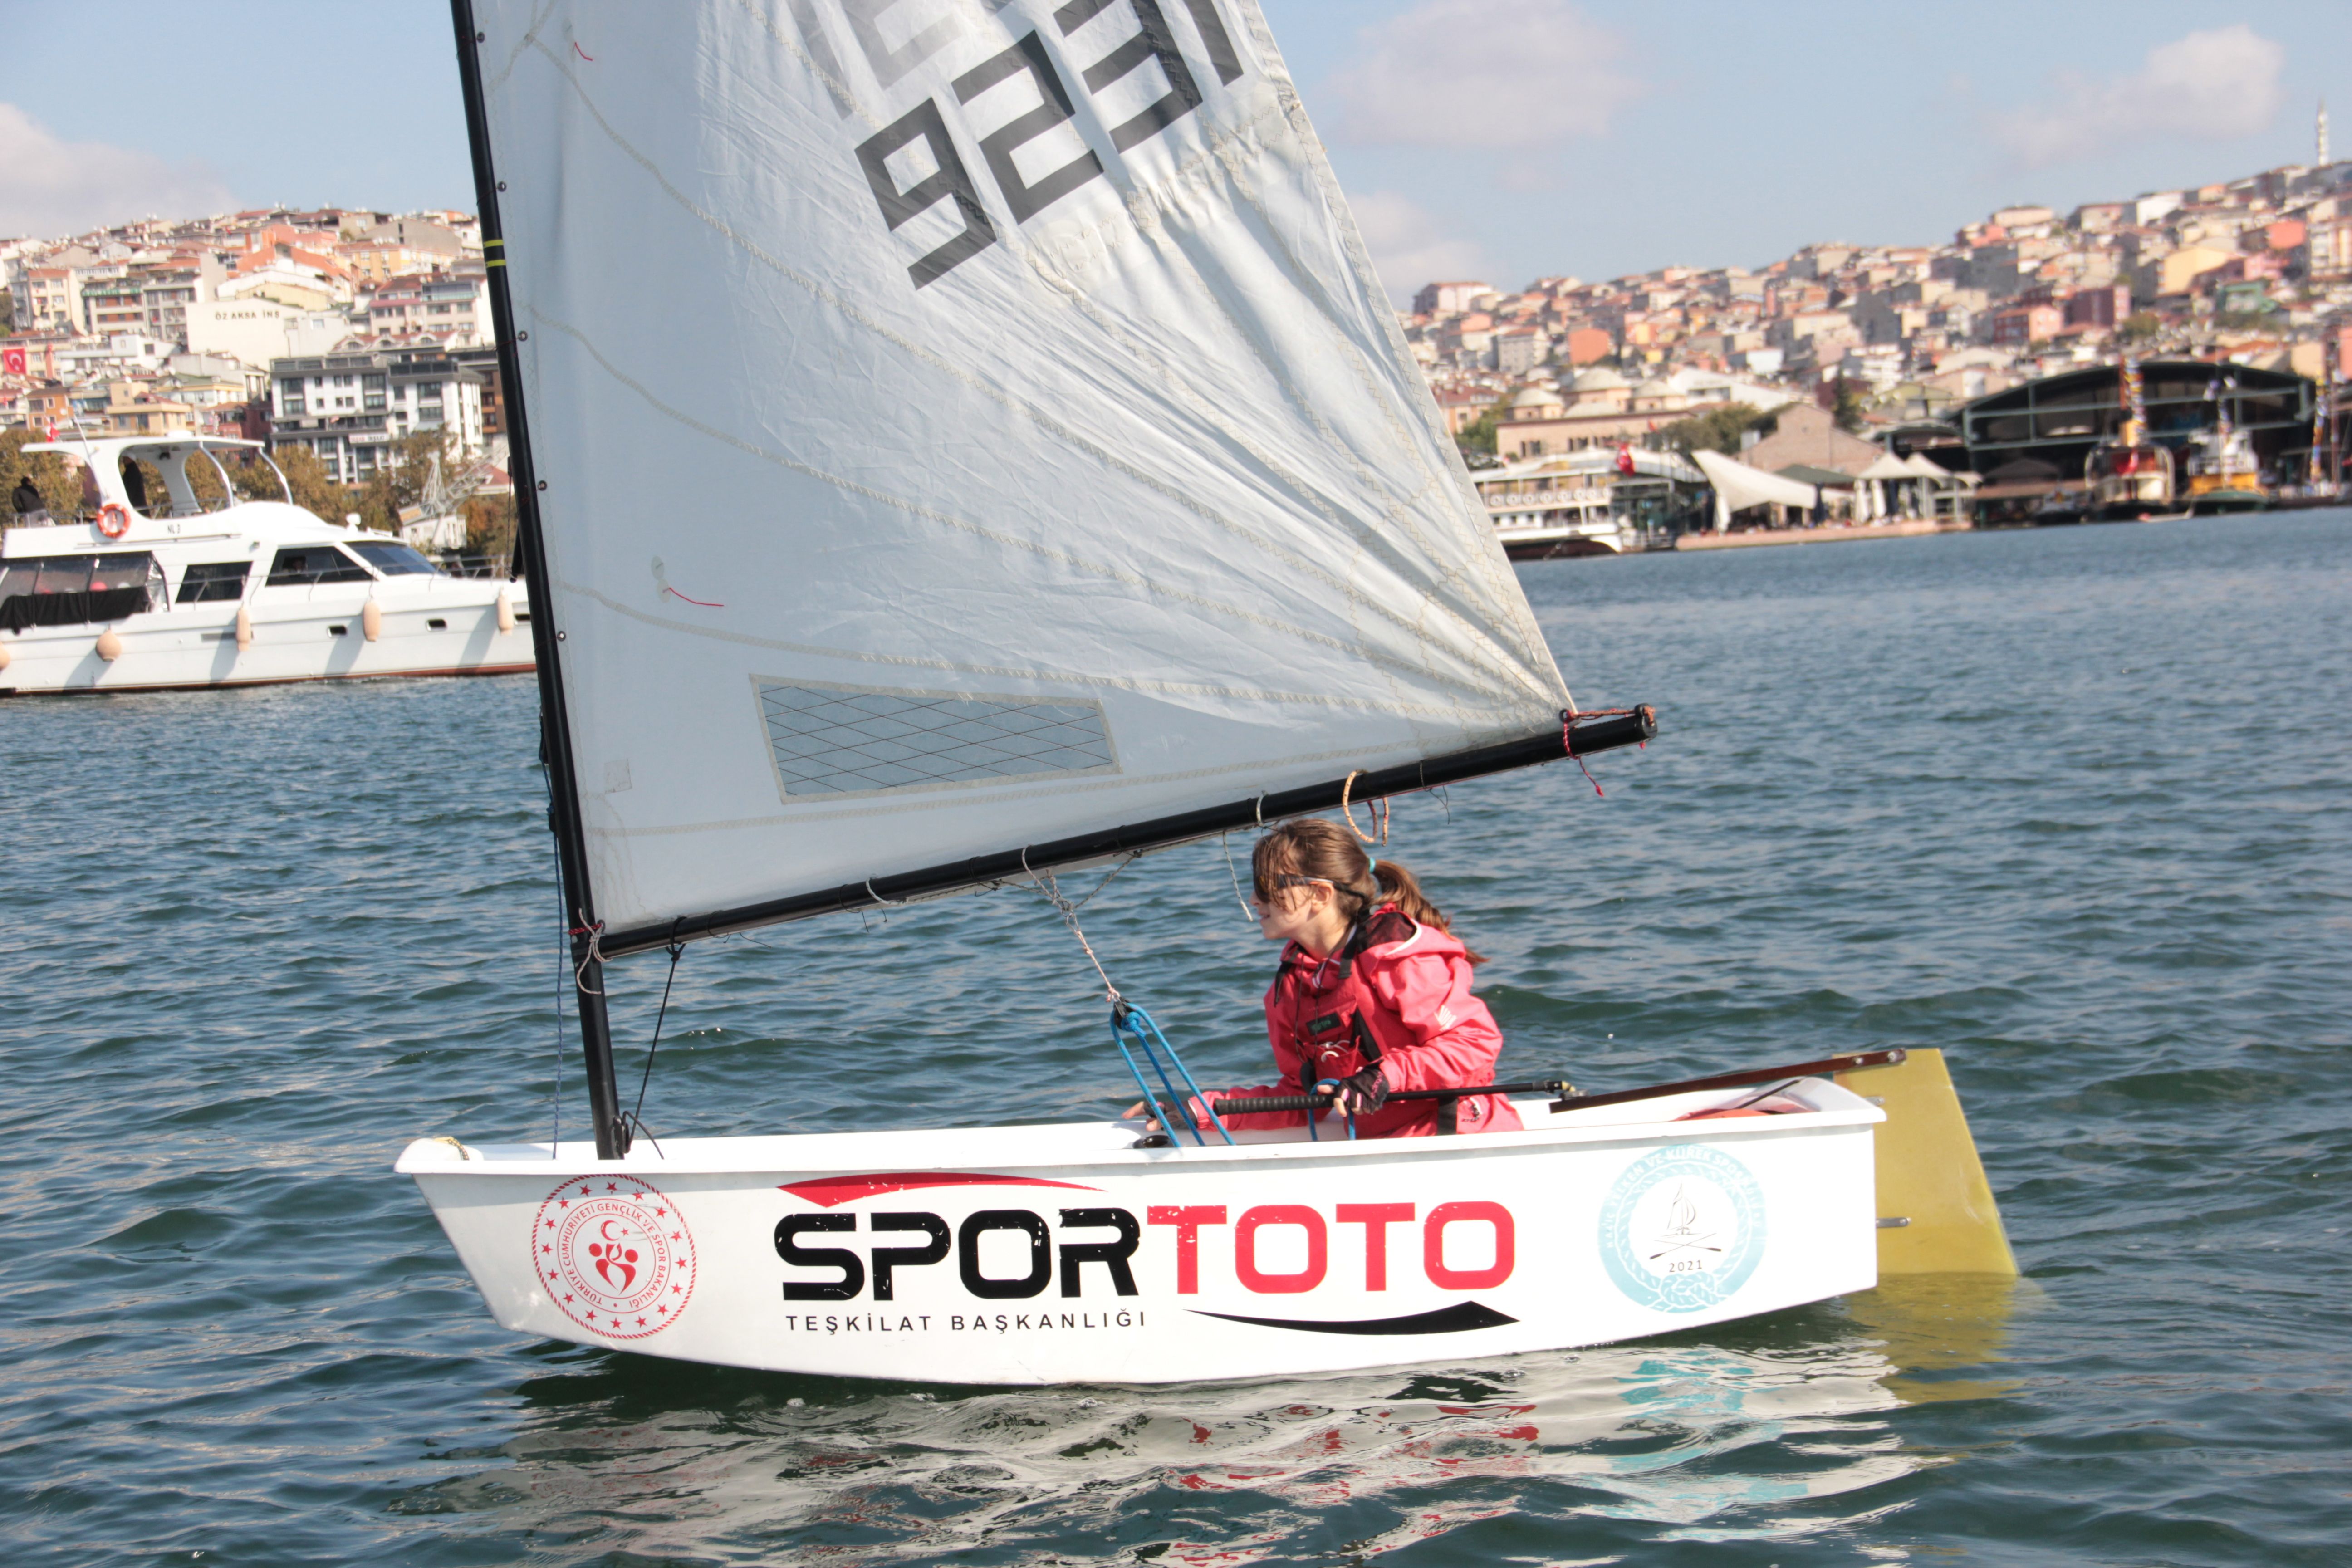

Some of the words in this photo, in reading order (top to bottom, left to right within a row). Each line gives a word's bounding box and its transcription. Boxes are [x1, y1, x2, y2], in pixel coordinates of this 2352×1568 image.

[215, 311, 228, 320] ÖZ
[231, 311, 257, 319] AKSA
[1611, 1165, 1646, 1206] YELKEN
[1645, 1154, 1665, 1168] VE
[1666, 1146, 1711, 1161] KÜREK
[597, 1203, 642, 1221] GENÇLİK
[642, 1219, 655, 1232] VE
[561, 1204, 595, 1266] CUMHURİYETİ
[652, 1234, 666, 1262] SPOR
[1669, 1260, 1703, 1273] 2021
[567, 1269, 602, 1305] TÜRKİYE
[629, 1265, 666, 1308] BAKANLIĞI
[786, 1313, 931, 1334] TEŞKİLAT
[951, 1308, 1145, 1334] BAŞKANLIĞI
